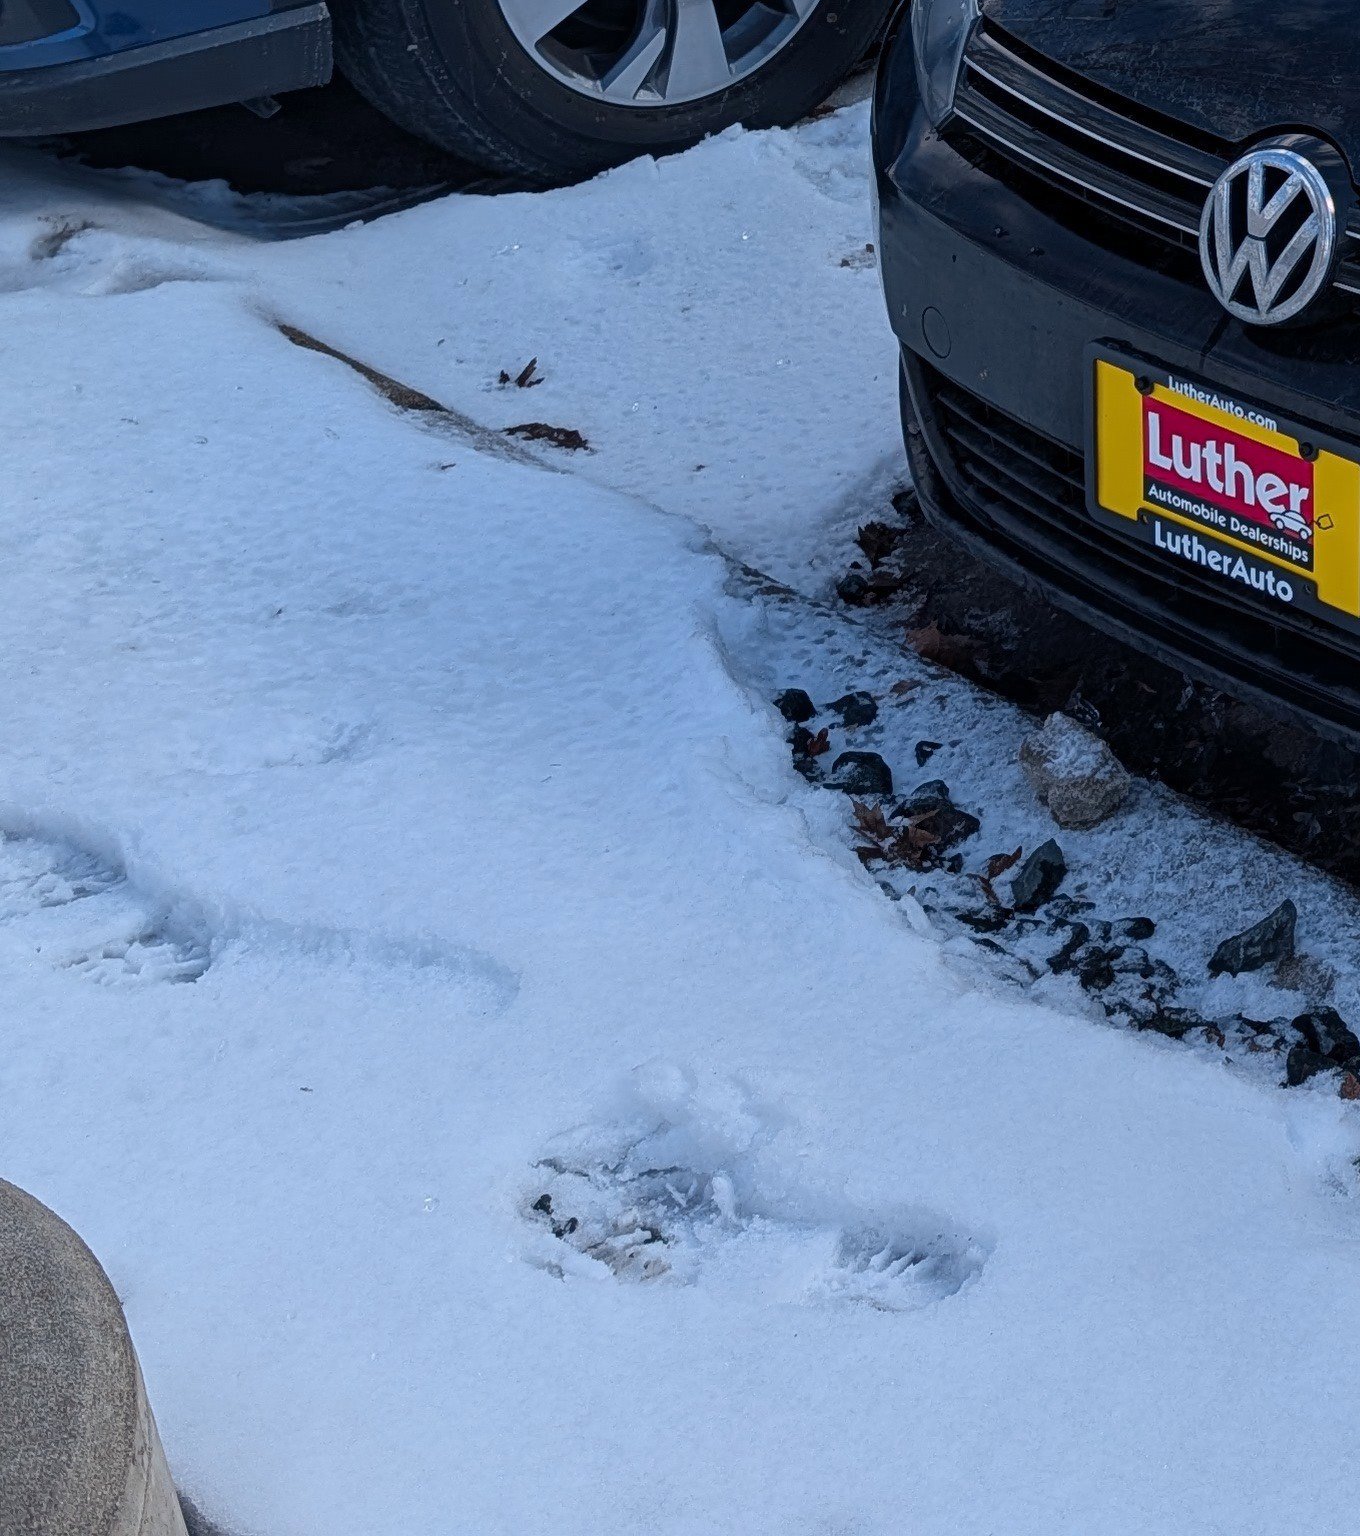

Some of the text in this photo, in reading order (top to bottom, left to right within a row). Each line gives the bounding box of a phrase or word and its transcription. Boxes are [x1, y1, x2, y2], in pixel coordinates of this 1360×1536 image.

[1168, 375, 1278, 432] LutherAuto.com
[1147, 411, 1310, 513] Luther
[1147, 483, 1309, 564] Automobile Dealerships
[1154, 521, 1294, 602] LutherAuto
